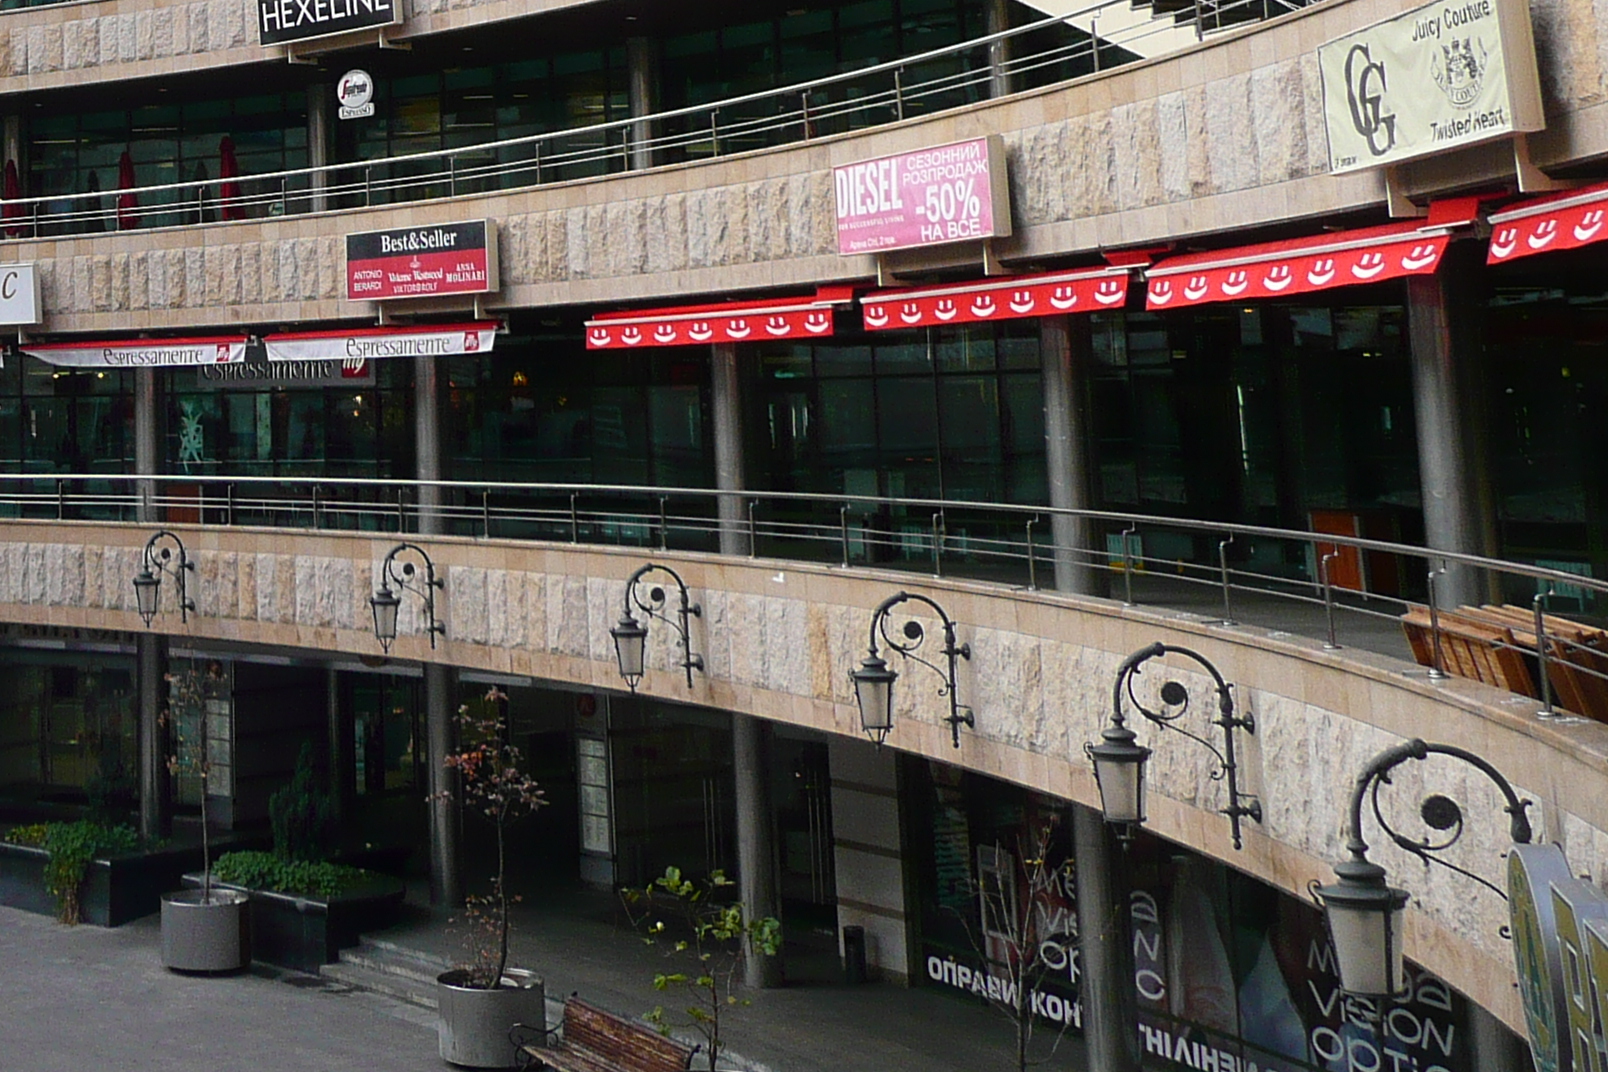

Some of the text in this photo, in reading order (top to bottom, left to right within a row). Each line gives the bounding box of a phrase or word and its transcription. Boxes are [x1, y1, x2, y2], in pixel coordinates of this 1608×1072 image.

[1412, 0, 1491, 42] Juicy Couture
[1429, 105, 1506, 142] Twisted Heart
[906, 142, 980, 170] СЕЗОННИЙ
[902, 159, 988, 187] РОЗПРОДАЖ
[835, 159, 903, 219] DIESEL
[915, 179, 981, 223] -50%
[381, 229, 458, 253] Best&Seller
[921, 218, 981, 242] НА ВСЕ
[446, 270, 485, 283] MOLINARI
[103, 348, 203, 365] espressamente
[346, 337, 451, 357] espressamente
[927, 956, 1023, 1010] ОПРАВИ
